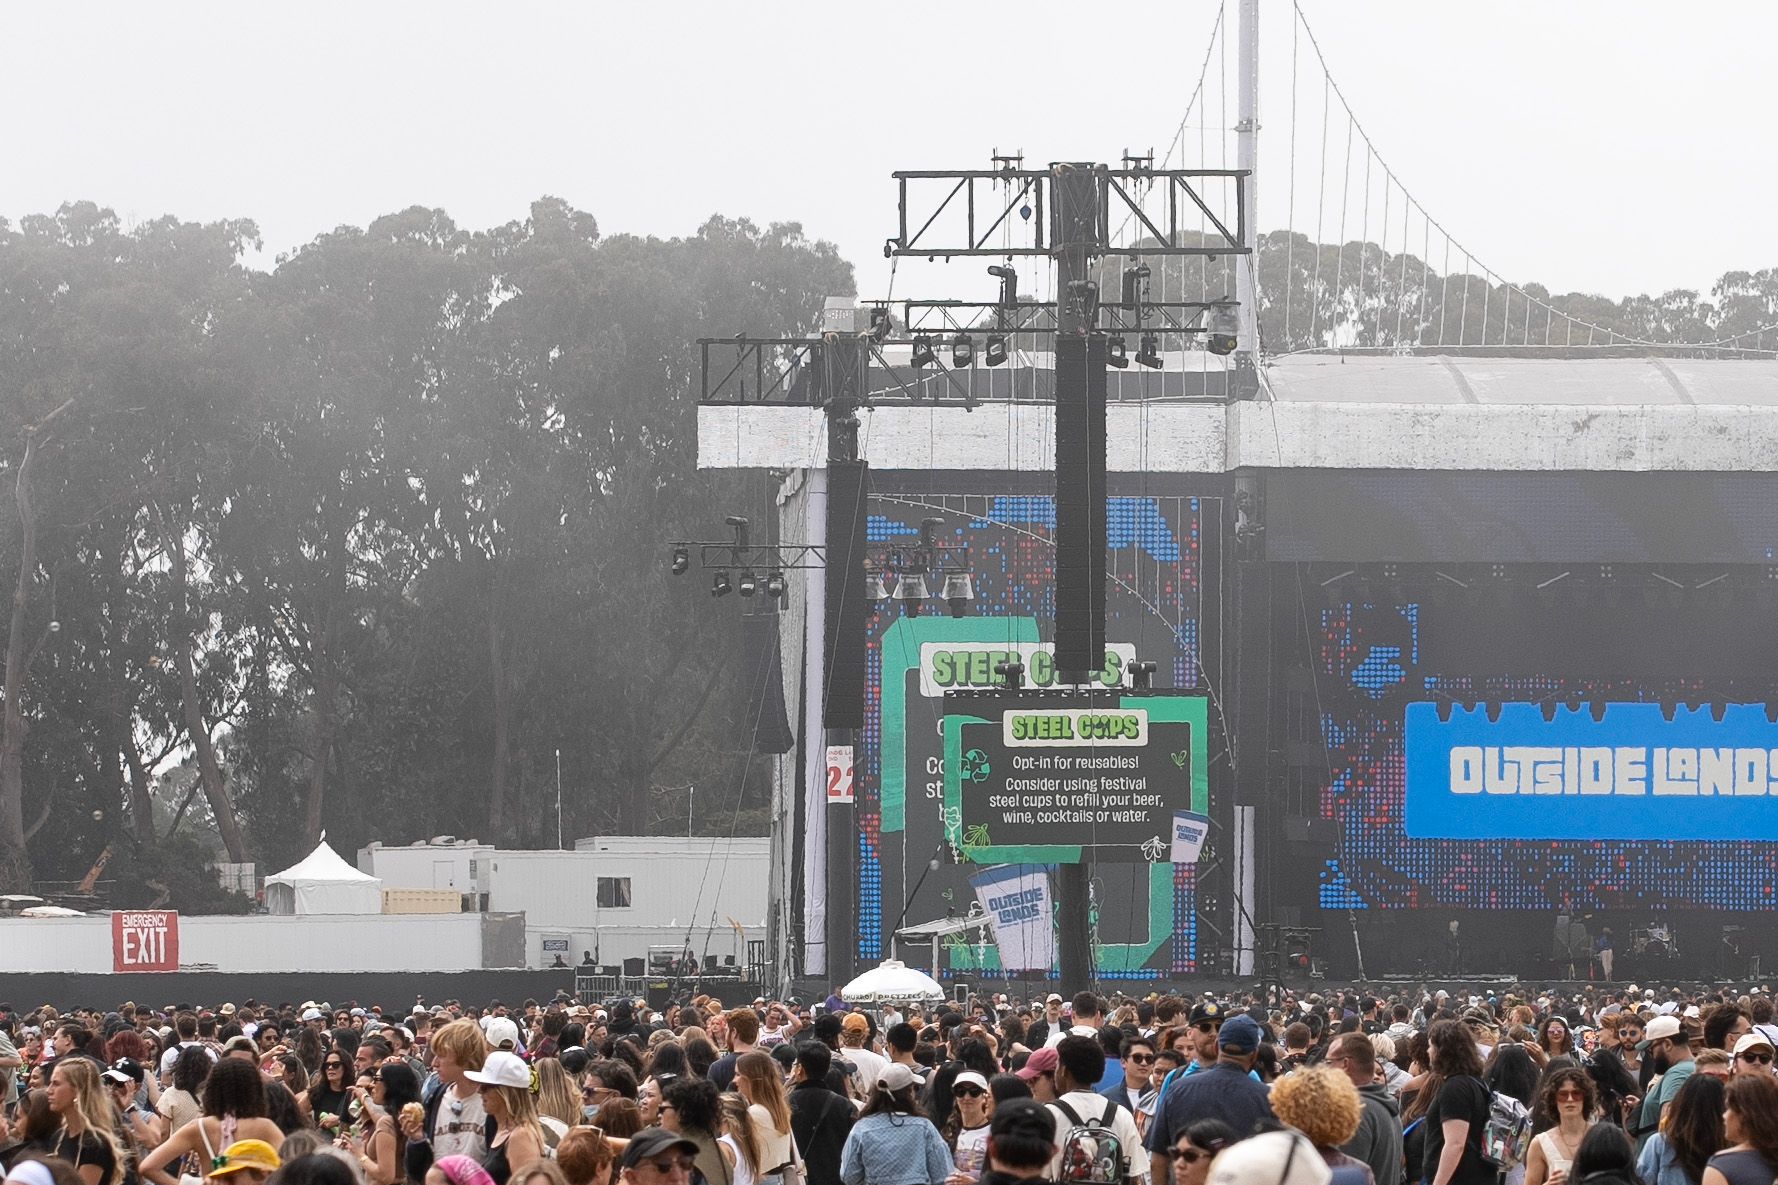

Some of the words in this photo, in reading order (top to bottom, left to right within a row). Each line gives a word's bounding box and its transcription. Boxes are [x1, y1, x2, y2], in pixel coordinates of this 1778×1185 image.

[1012, 715, 1074, 739] STEEL
[1077, 715, 1139, 739] CUPS
[1013, 756, 1050, 772] Opt-in
[1054, 756, 1072, 769] for
[1076, 755, 1139, 769] reusables!
[1449, 746, 1646, 795] OUTSIDE
[1006, 778, 1060, 791] Consider
[1063, 778, 1097, 793] using
[1100, 777, 1146, 791] festival
[989, 794, 1019, 807] steel
[1022, 795, 1052, 810] cups
[1055, 794, 1068, 807] to
[1071, 793, 1099, 807] refill
[1102, 795, 1129, 809] your
[1132, 794, 1164, 808] beer,
[1003, 810, 1034, 824] wine,
[1037, 810, 1093, 823] cocktails
[1097, 811, 1109, 823] or
[1112, 810, 1150, 823] water.
[989, 887, 1044, 912] OUTSIDE
[122, 914, 167, 928] EMERGENCY
[998, 903, 1040, 924] LANDS
[123, 927, 168, 964] EXIT
